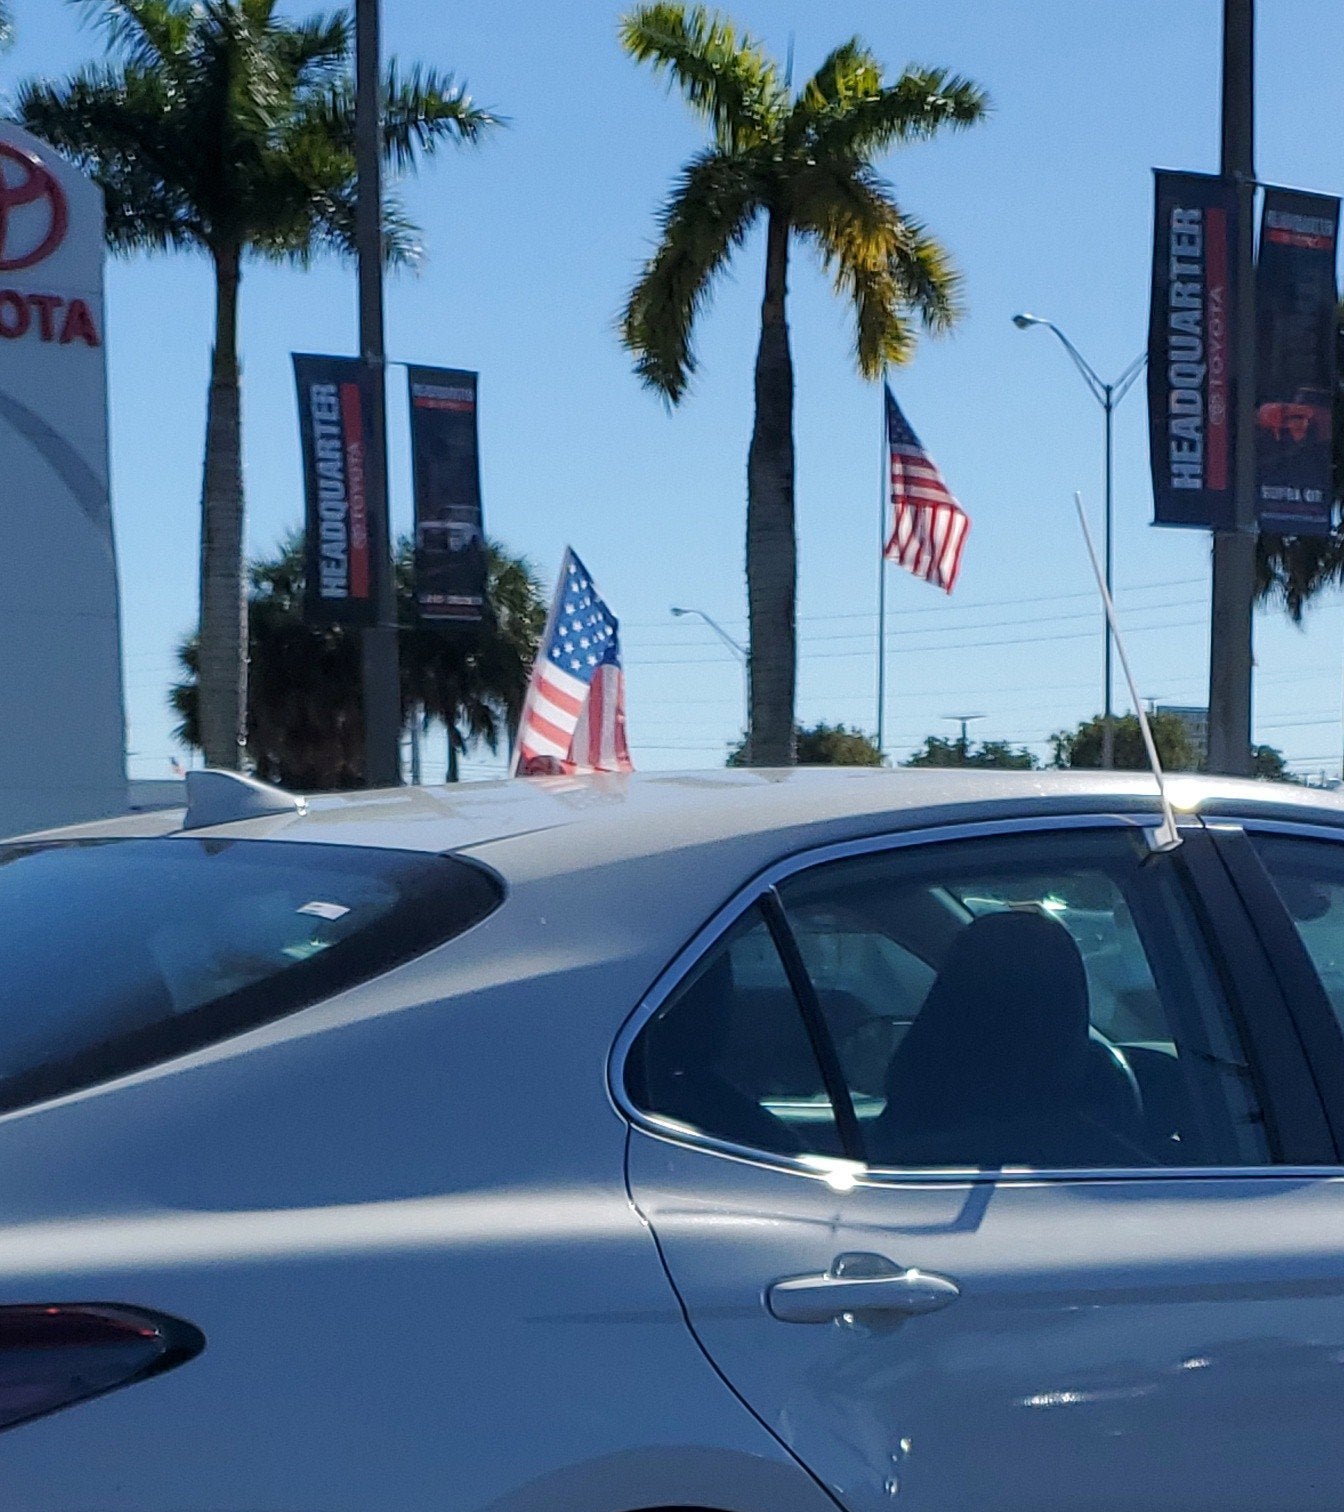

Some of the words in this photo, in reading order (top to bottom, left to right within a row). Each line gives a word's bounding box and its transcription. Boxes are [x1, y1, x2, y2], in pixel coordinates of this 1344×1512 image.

[1169, 206, 1206, 490] HEADQUARTER
[1208, 286, 1225, 389] TOYOTA
[309, 382, 349, 599] HEADQUARTER
